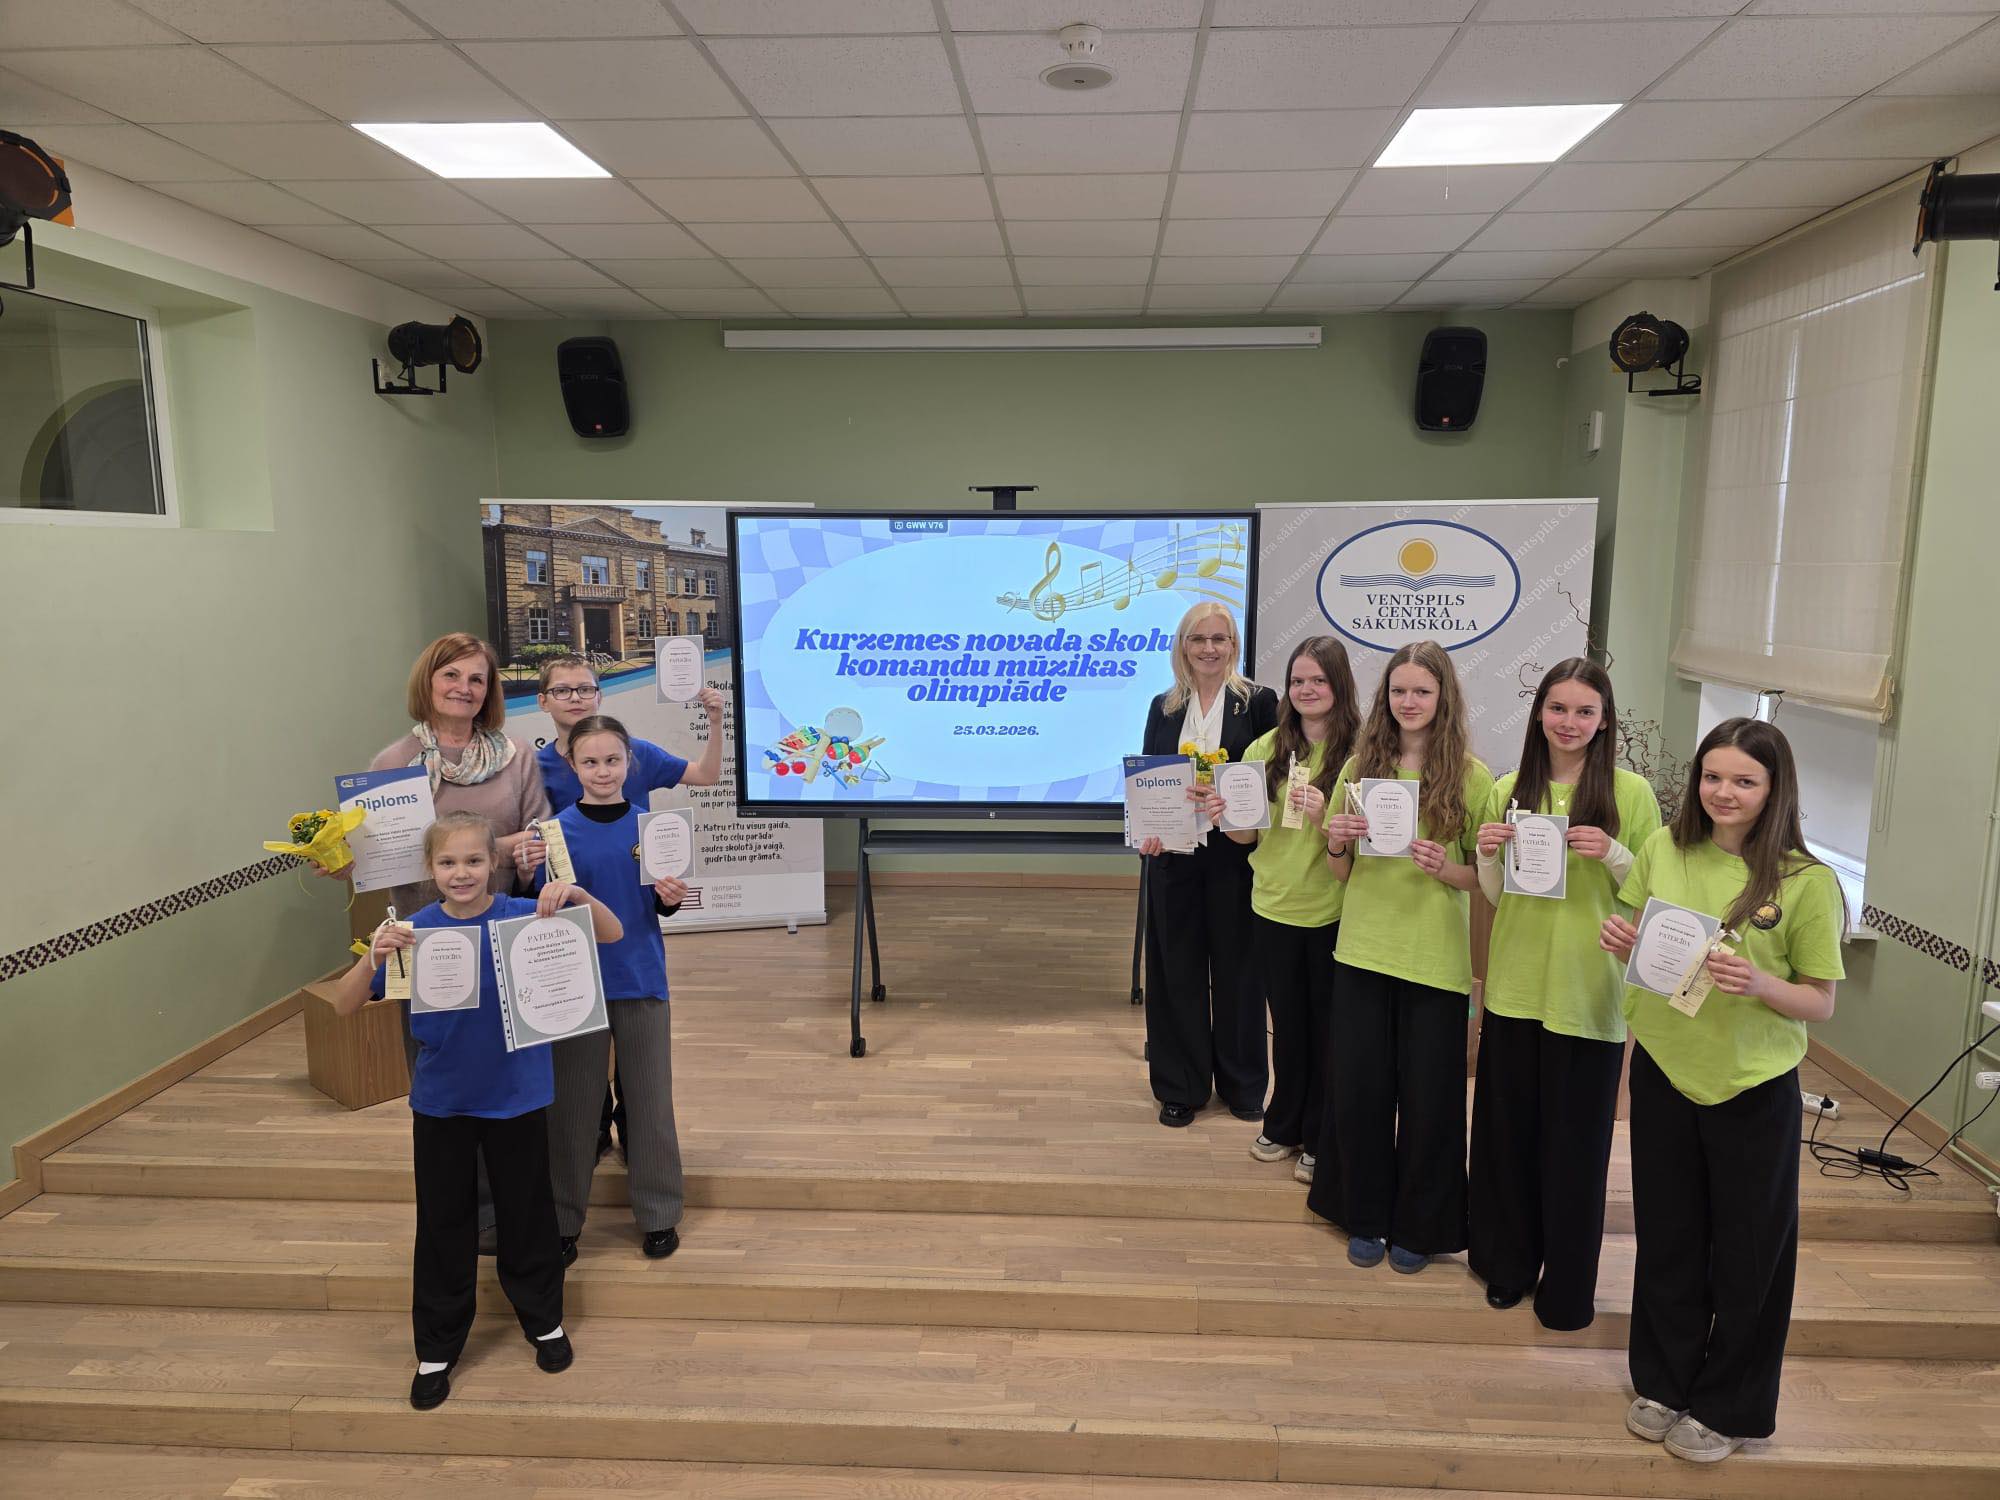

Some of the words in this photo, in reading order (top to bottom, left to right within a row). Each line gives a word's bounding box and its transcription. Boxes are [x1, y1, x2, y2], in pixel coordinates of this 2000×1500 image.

[1513, 517, 1559, 562] entspils
[1366, 594, 1466, 606] VENTSPILS
[1507, 574, 1555, 622] entspils
[1378, 606, 1451, 618] CENTRA
[1272, 604, 1321, 651] sākumsk
[1352, 615, 1479, 631] SĀKUMSKOLA
[794, 627, 961, 652] Kurzemes
[964, 627, 1084, 653] novada
[1458, 649, 1489, 678] skola
[1495, 631, 1552, 680] Ventspils
[835, 653, 991, 677] komandu
[994, 653, 1137, 678] mūzikas
[706, 680, 734, 691] Skola
[907, 678, 1068, 707] olimpiāde
[953, 725, 1040, 736] 25.03.2026.
[1136, 777, 1182, 789] Diploms
[355, 793, 418, 812] Diploms
[727, 800, 737, 808] pa
[703, 823, 726, 832] Katru
[727, 822, 745, 830] rītu
[704, 854, 736, 866] gudrība
